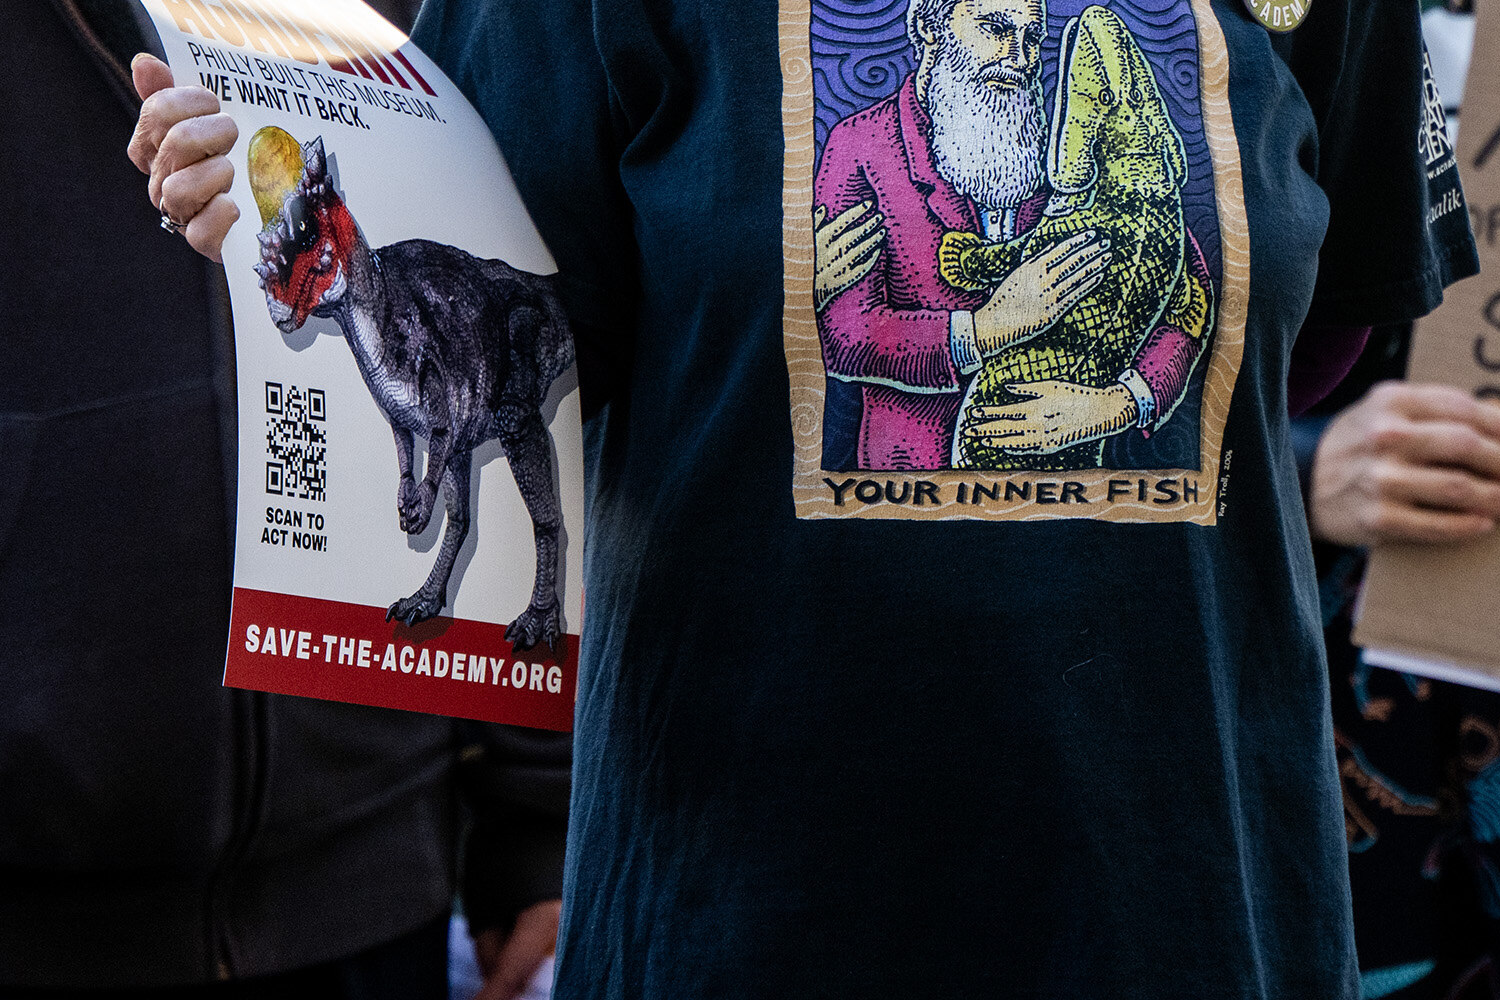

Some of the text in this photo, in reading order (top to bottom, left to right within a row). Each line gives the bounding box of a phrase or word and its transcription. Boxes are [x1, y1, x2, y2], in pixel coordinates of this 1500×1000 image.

[187, 41, 447, 124] PHILLY BUILT THIS MUSEUM.
[199, 72, 371, 130] WE WANT IT BACK.
[822, 477, 1199, 508] YOUR INNER FISH
[260, 527, 328, 553] ACT NOW!
[265, 506, 325, 531] SCAN TO
[244, 624, 563, 694] SAVE-THE-ACADEMY.ORG
